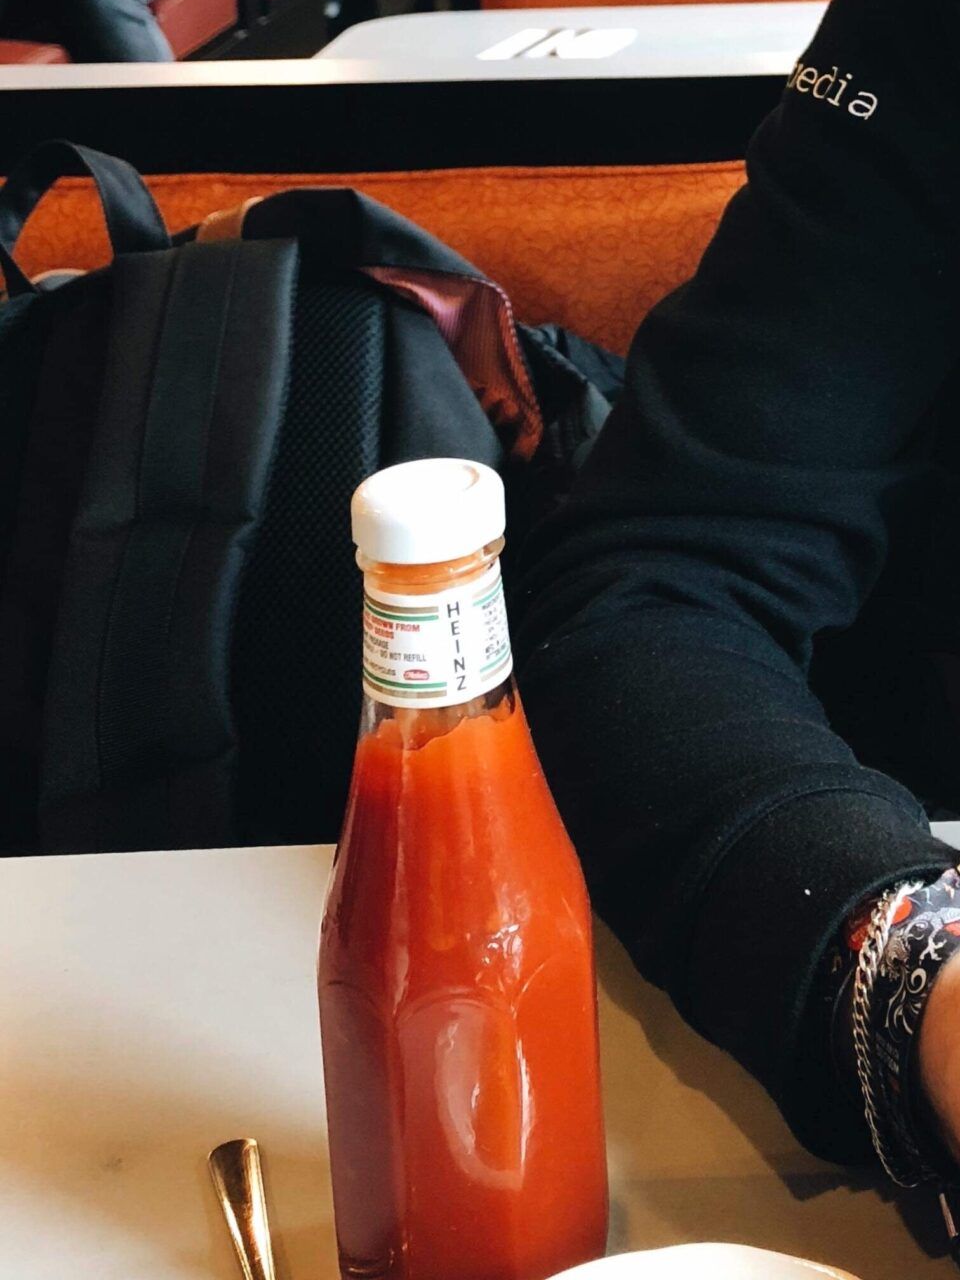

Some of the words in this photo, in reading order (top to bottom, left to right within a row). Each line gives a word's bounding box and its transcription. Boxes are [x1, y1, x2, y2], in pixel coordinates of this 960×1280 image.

[395, 623, 421, 632] FROM
[447, 601, 467, 691] HEINZ
[389, 652, 402, 661] NOT
[403, 653, 427, 663] REFILL
